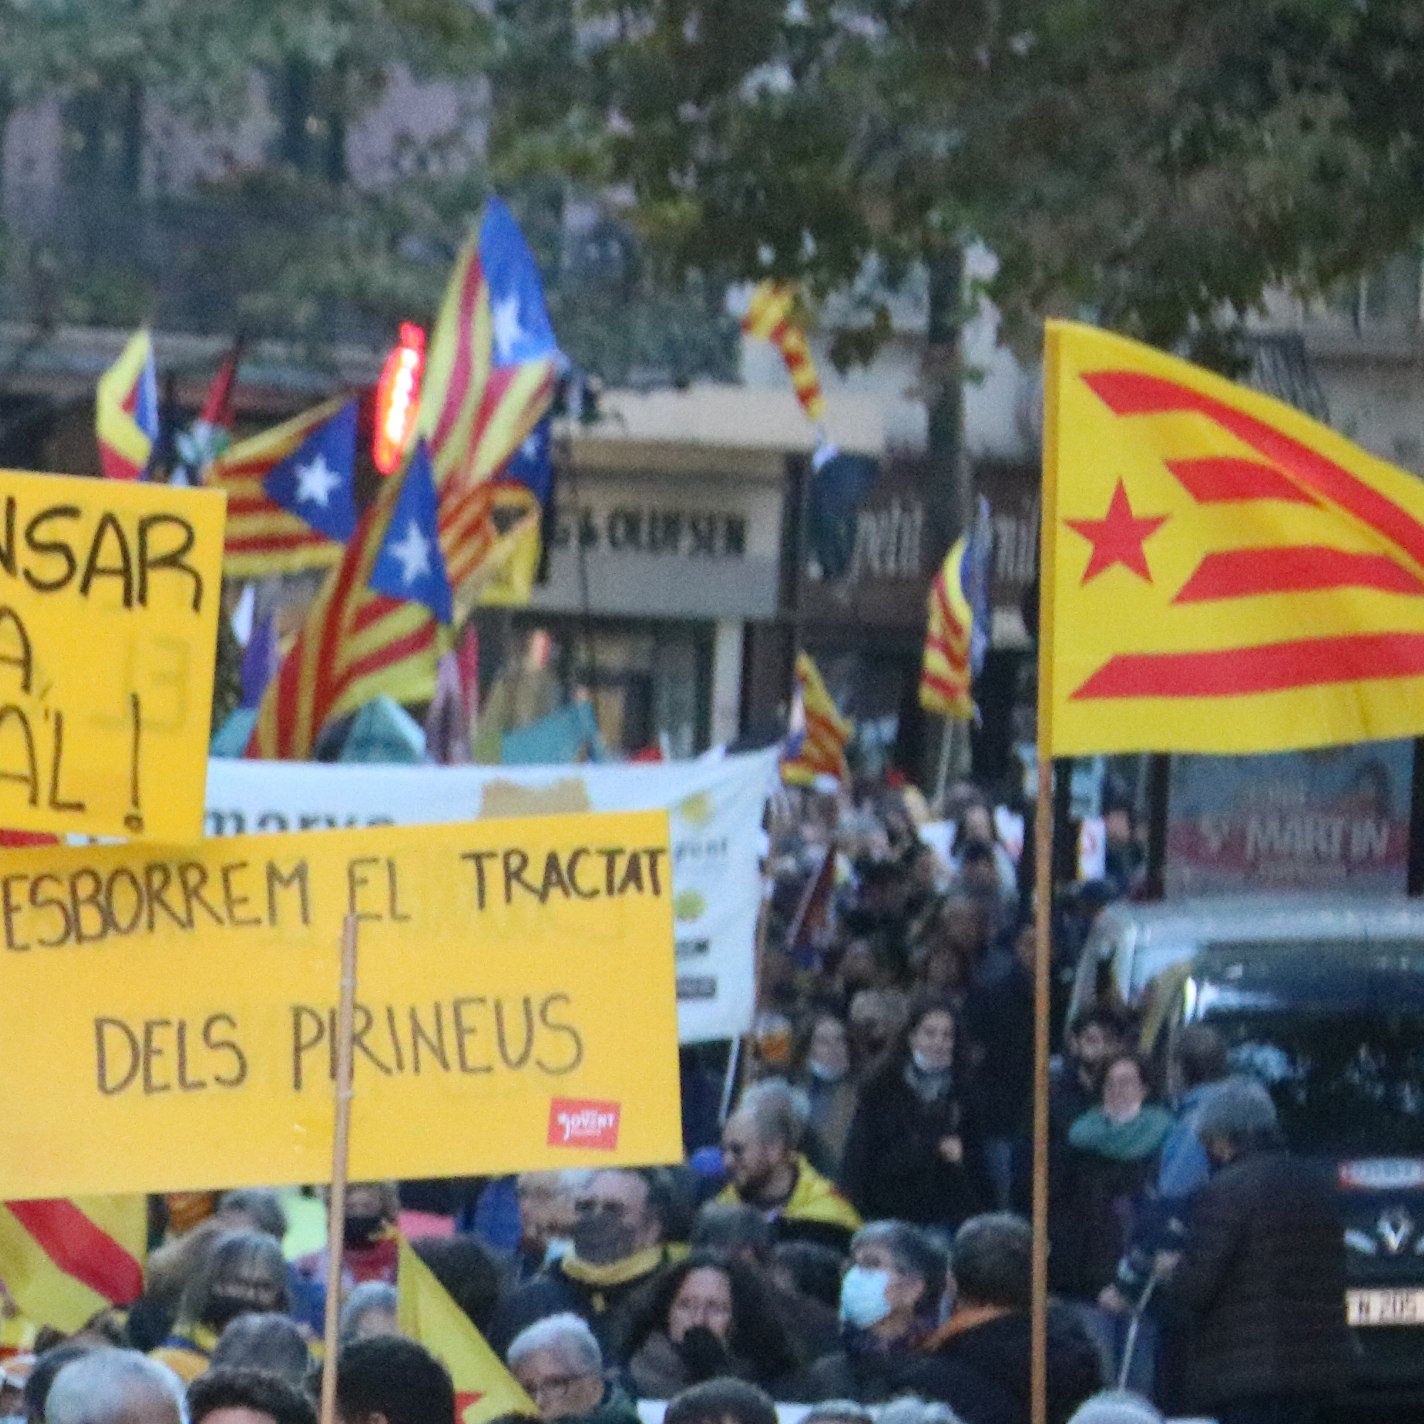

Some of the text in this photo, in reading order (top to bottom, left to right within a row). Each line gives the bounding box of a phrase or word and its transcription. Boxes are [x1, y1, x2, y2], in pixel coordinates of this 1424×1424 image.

[0, 845, 669, 953] ESBORREM EL TRACTAT
[95, 991, 585, 1096] DELS PIRINEUS
